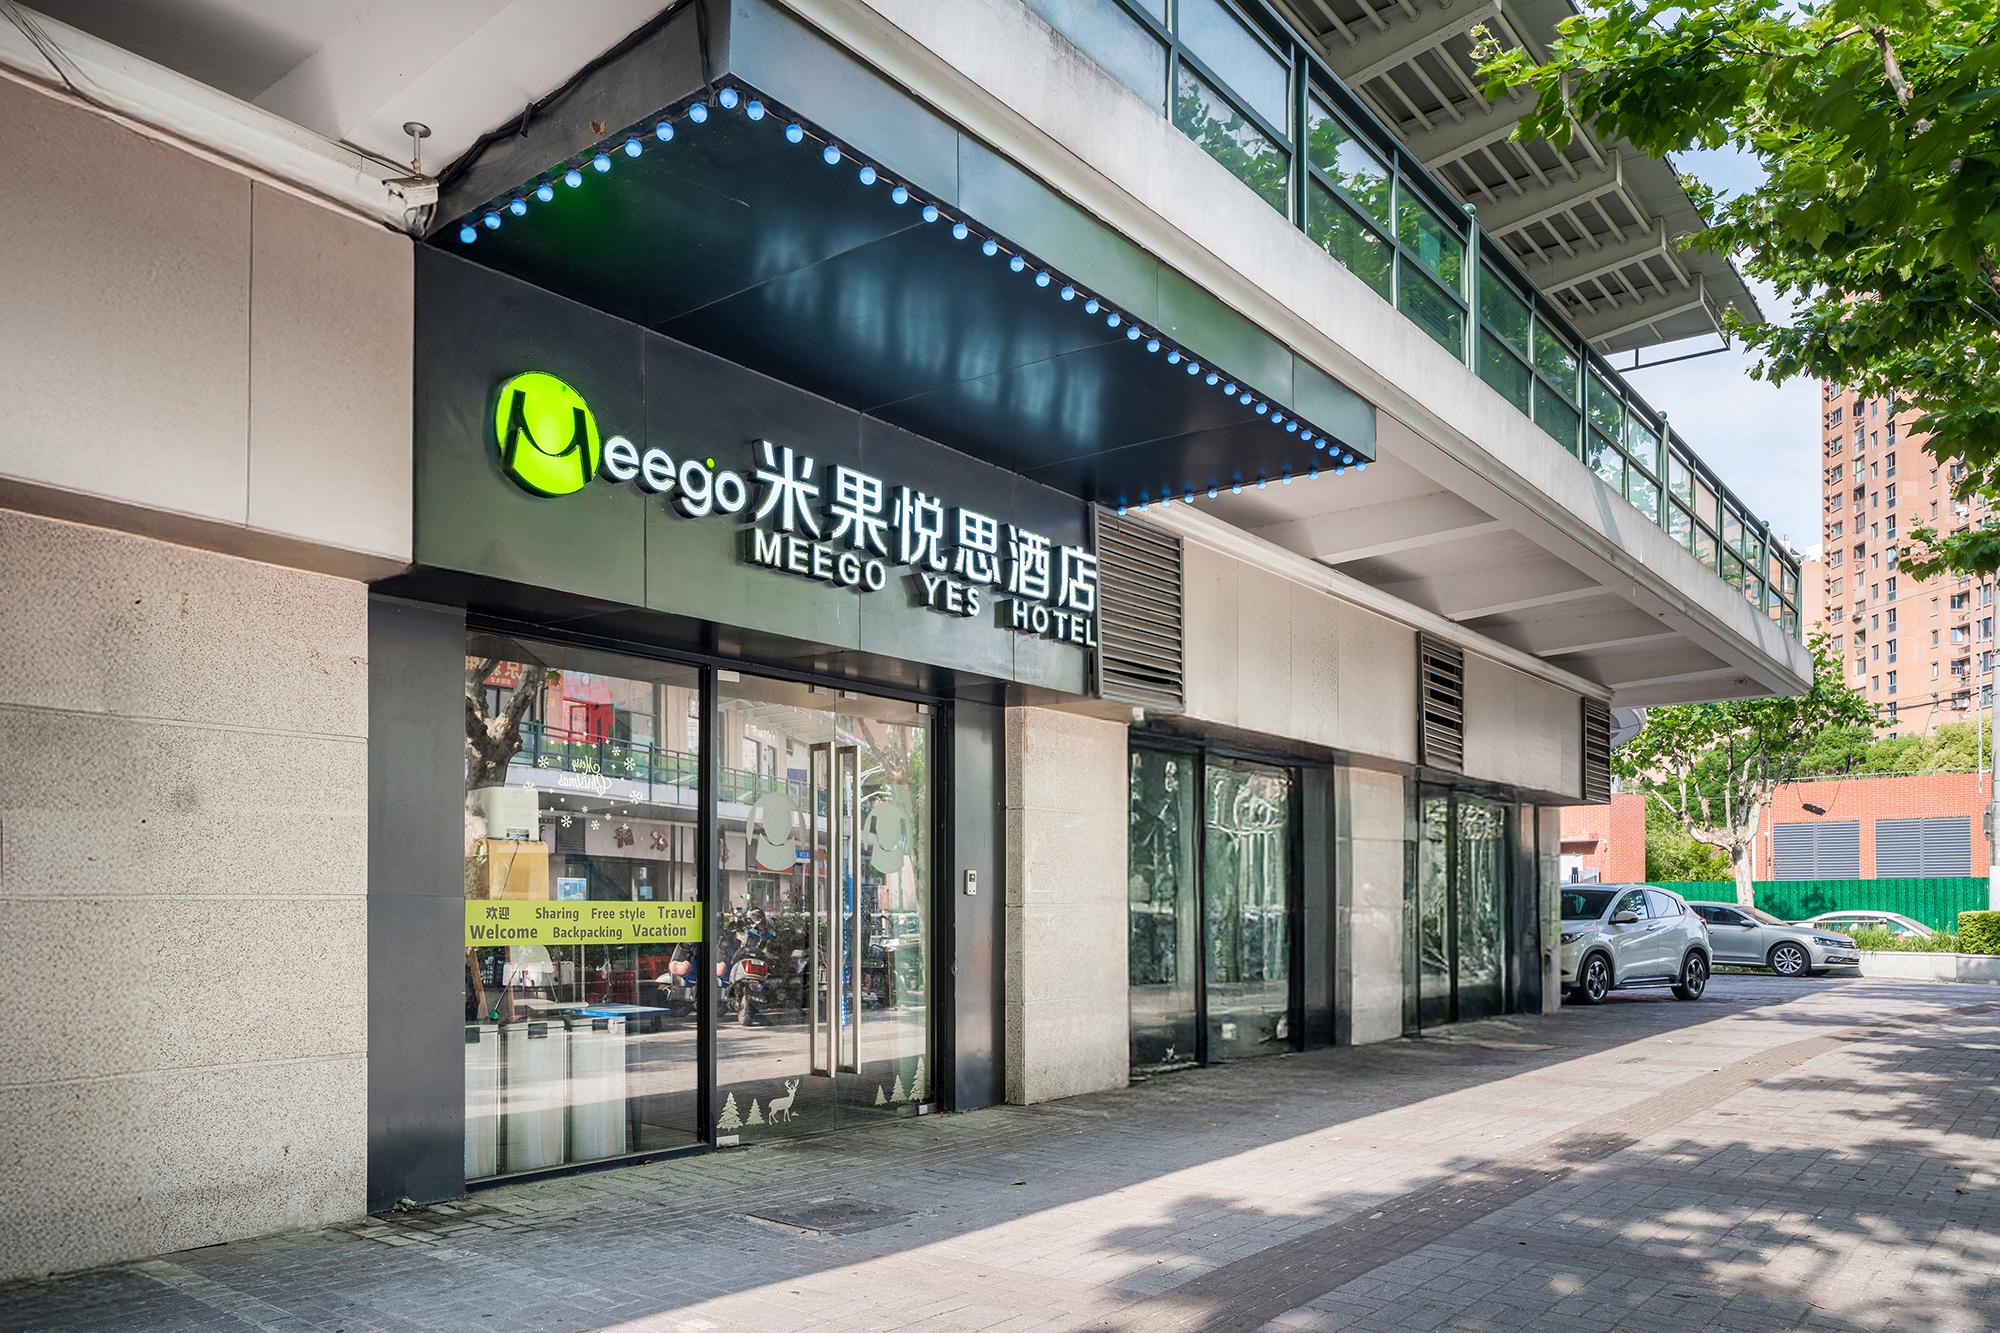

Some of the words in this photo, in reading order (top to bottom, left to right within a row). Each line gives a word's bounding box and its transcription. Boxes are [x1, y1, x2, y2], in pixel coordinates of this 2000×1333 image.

[755, 440, 1098, 613] 米果悦思酒店
[754, 528, 888, 592] MEEGO
[921, 572, 982, 617] YES
[1012, 597, 1098, 648] HOTEL
[485, 906, 510, 920] 欢迎
[535, 907, 580, 922] Sharing
[591, 908, 615, 919] Free
[619, 907, 646, 922] style
[657, 905, 696, 919] Travel
[469, 924, 538, 940] Welcome
[552, 926, 623, 941] Backpacking
[632, 923, 687, 937] Vacation
